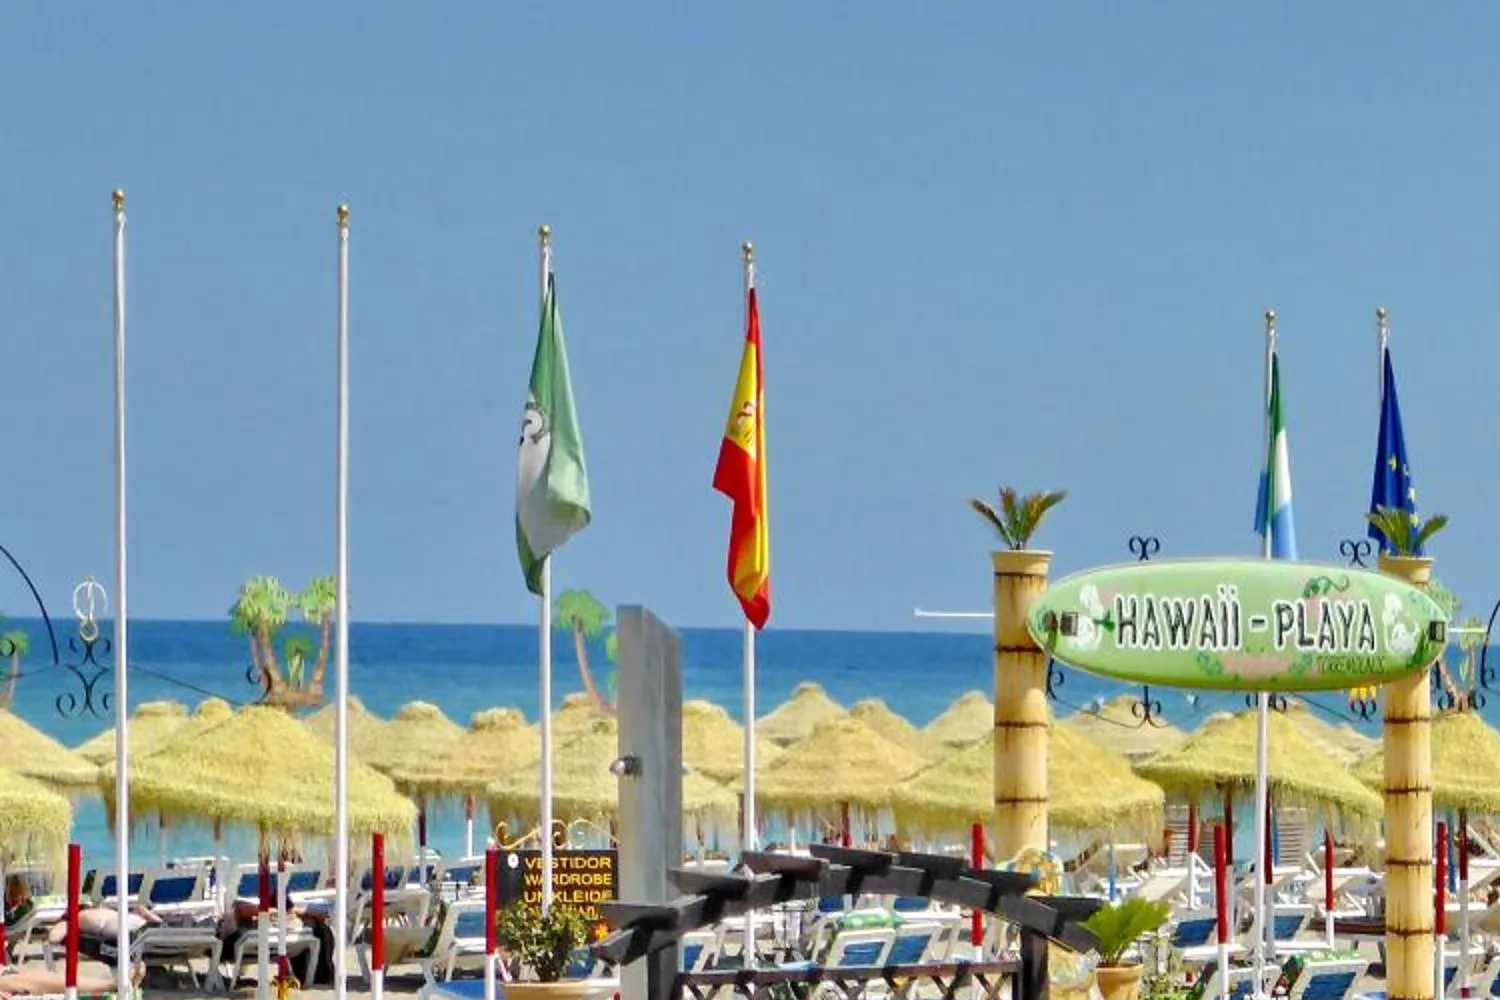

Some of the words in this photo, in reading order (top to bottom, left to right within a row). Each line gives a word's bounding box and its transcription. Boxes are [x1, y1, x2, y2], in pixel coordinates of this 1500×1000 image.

[1273, 600, 1377, 654] PLAYA
[524, 857, 612, 869] VESTIDOR
[523, 873, 613, 885] WRDROBE
